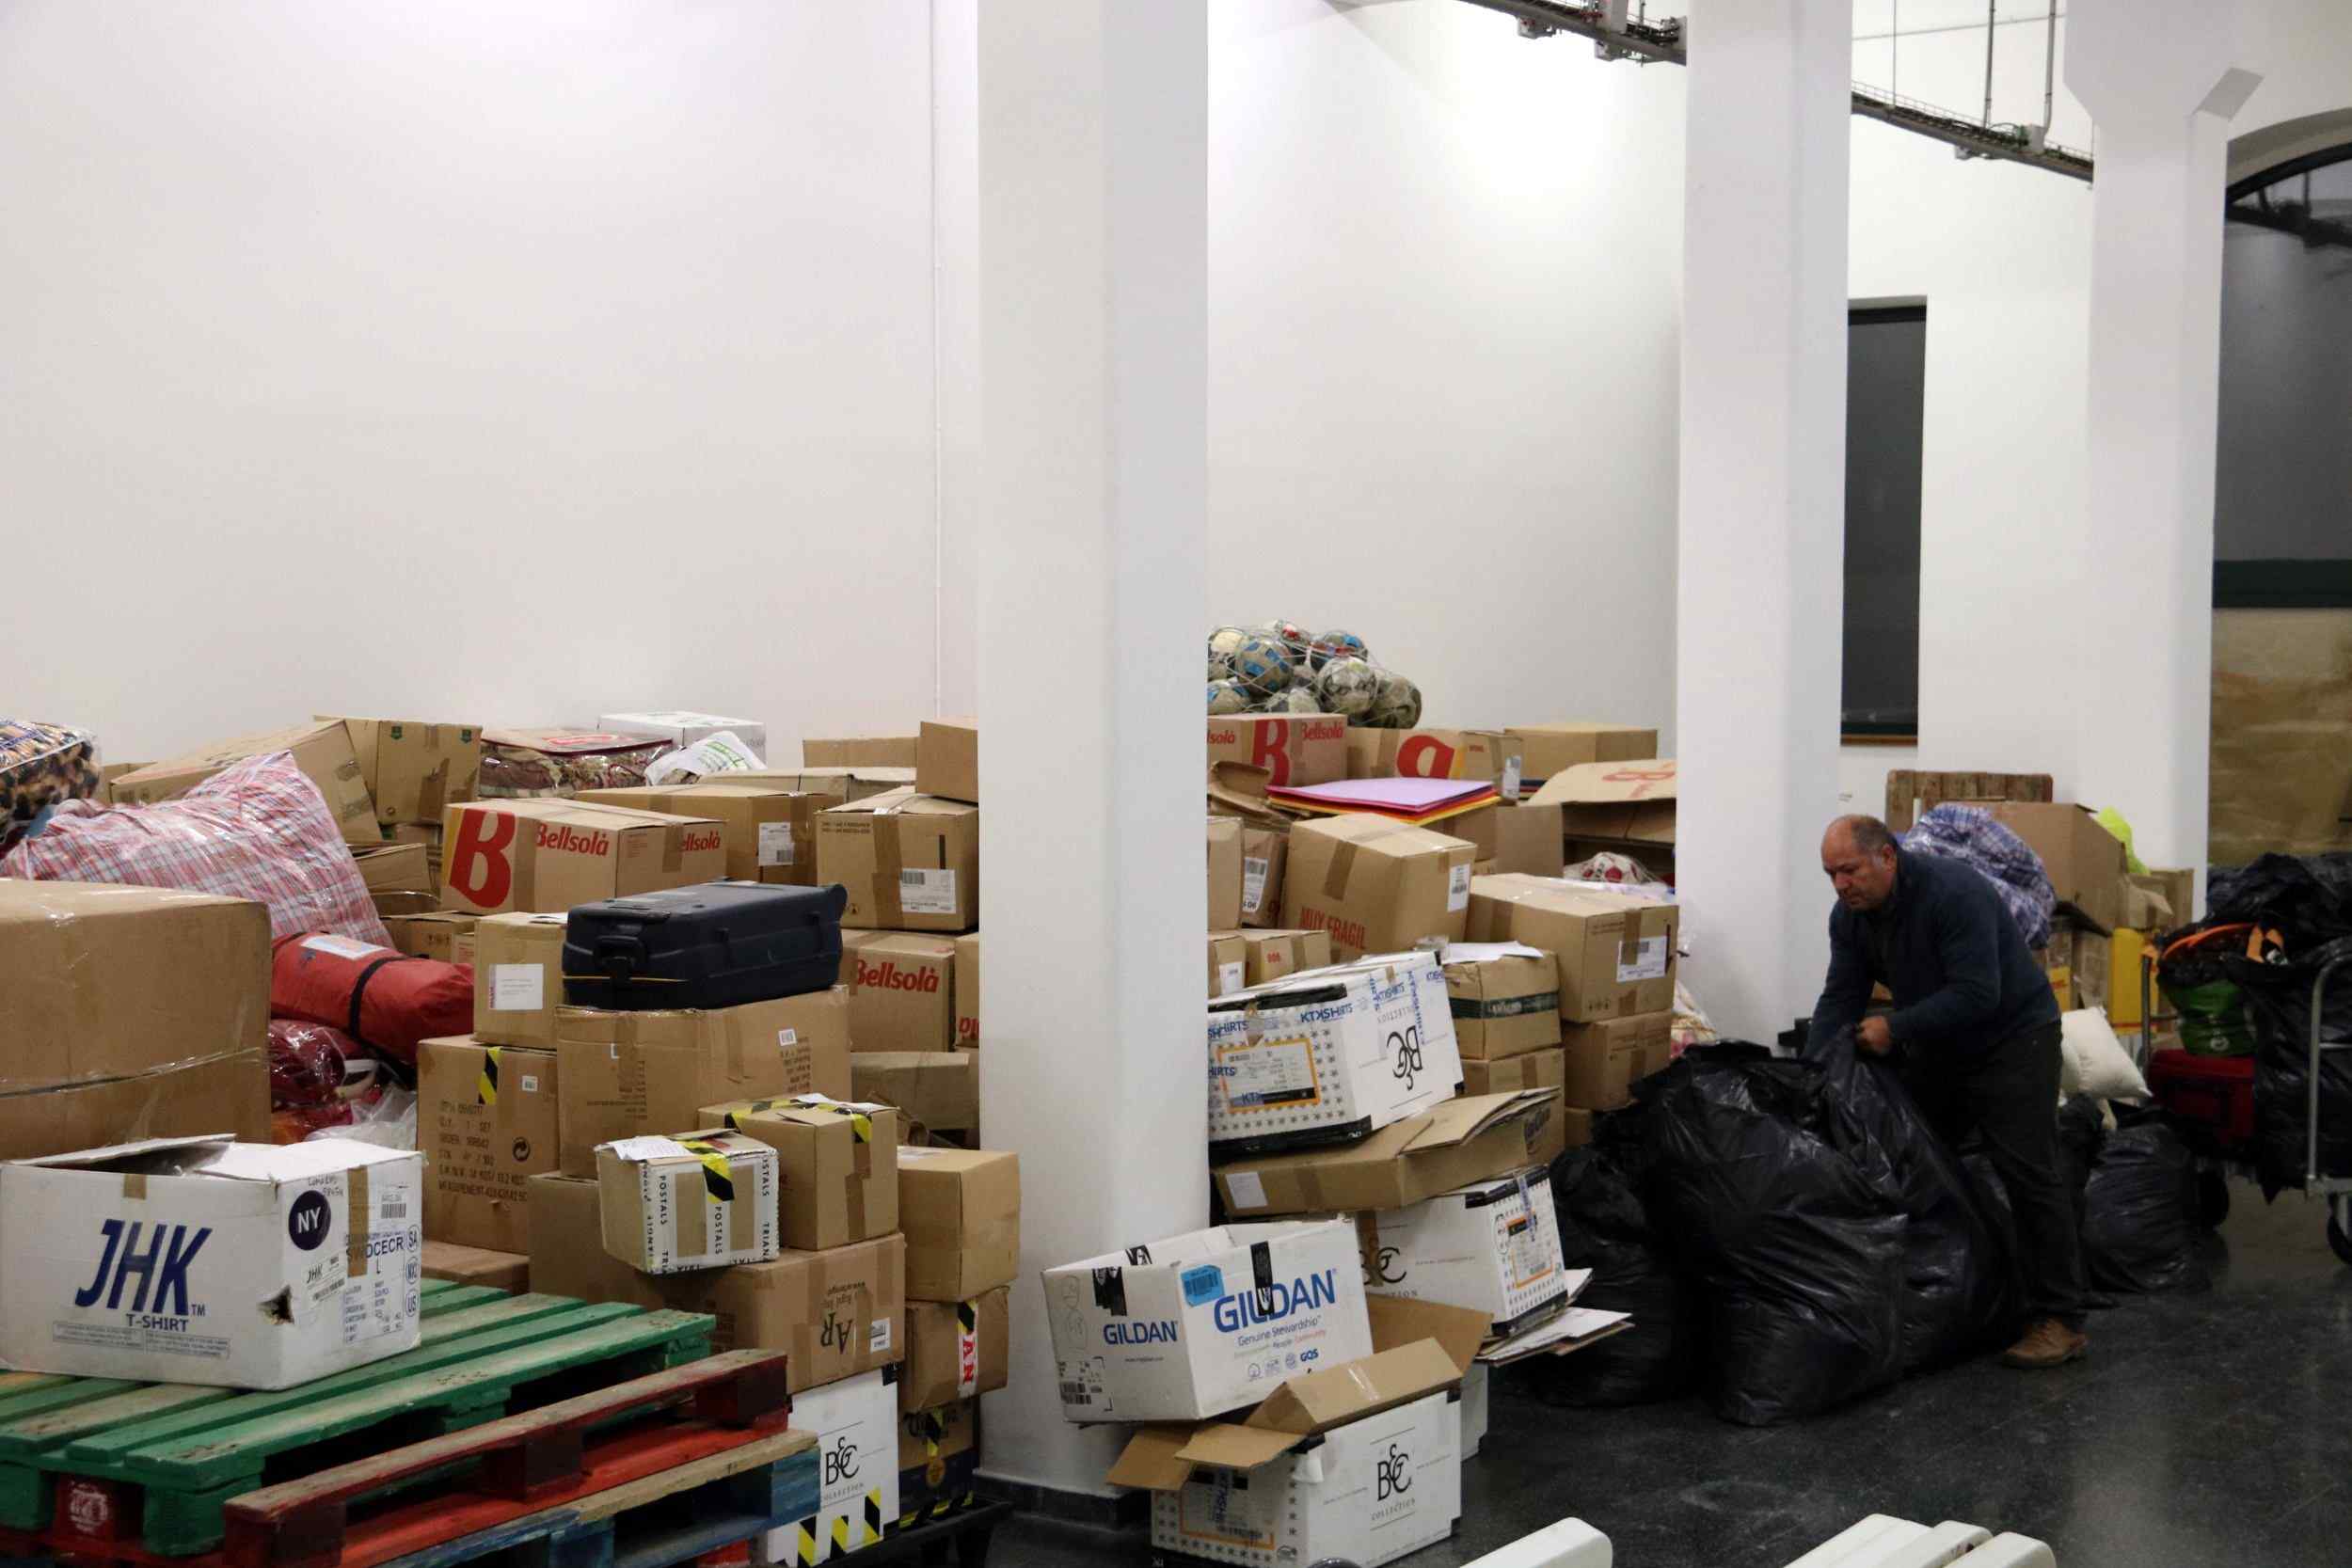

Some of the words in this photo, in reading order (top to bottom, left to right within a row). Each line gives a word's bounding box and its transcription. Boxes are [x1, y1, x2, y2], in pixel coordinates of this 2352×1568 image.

[449, 808, 516, 909] B
[660, 1176, 668, 1226] POSTALS
[297, 1207, 321, 1234] NY
[74, 1218, 213, 1317] JHK
[1214, 1270, 1335, 1334] GILDAN
[126, 1313, 188, 1332] T-SHIRT
[1103, 1320, 1178, 1345] GILDAN
[1238, 1330, 1271, 1347] Genuine
